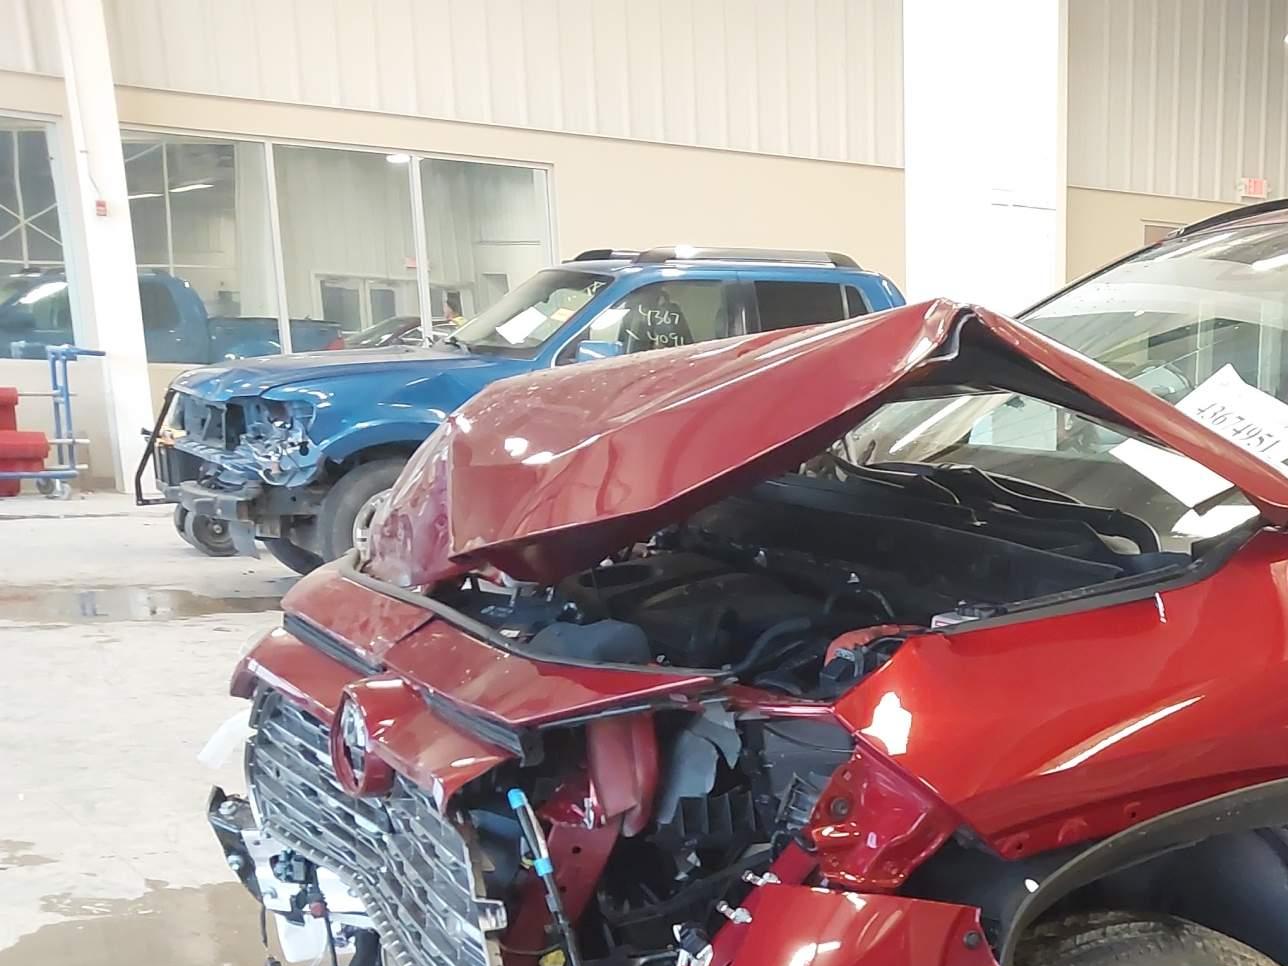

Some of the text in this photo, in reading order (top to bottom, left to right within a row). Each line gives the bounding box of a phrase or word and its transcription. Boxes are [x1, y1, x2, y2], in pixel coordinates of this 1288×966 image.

[638, 303, 681, 327] 4367
[646, 331, 685, 347] 4091
[1196, 402, 1281, 454] 43674951
